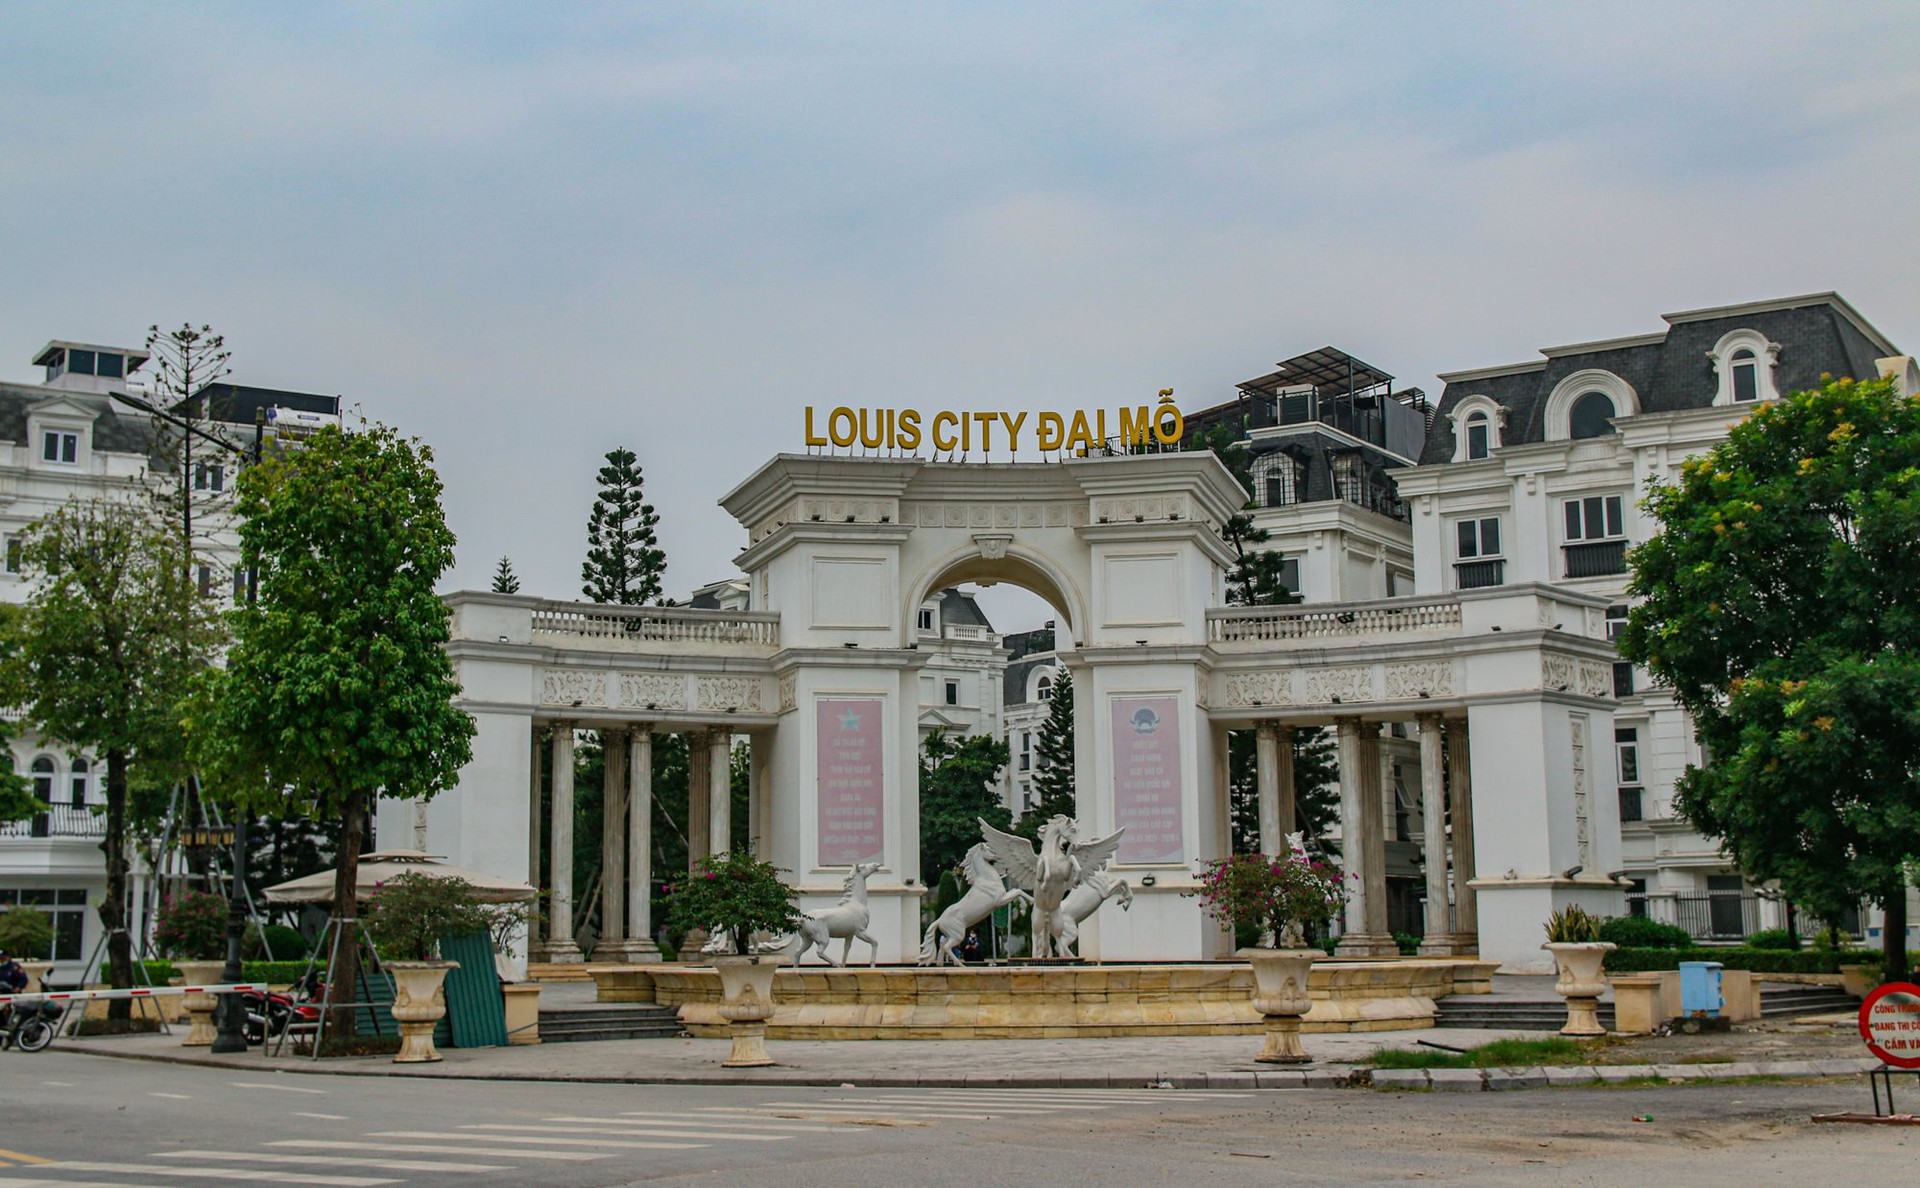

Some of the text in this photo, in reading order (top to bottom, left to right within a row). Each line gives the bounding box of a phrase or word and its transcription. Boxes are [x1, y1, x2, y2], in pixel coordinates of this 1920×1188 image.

[805, 388, 1184, 457] LOUIS CITY ĐẠI MỖ
[1898, 1021, 1909, 1030] THI
